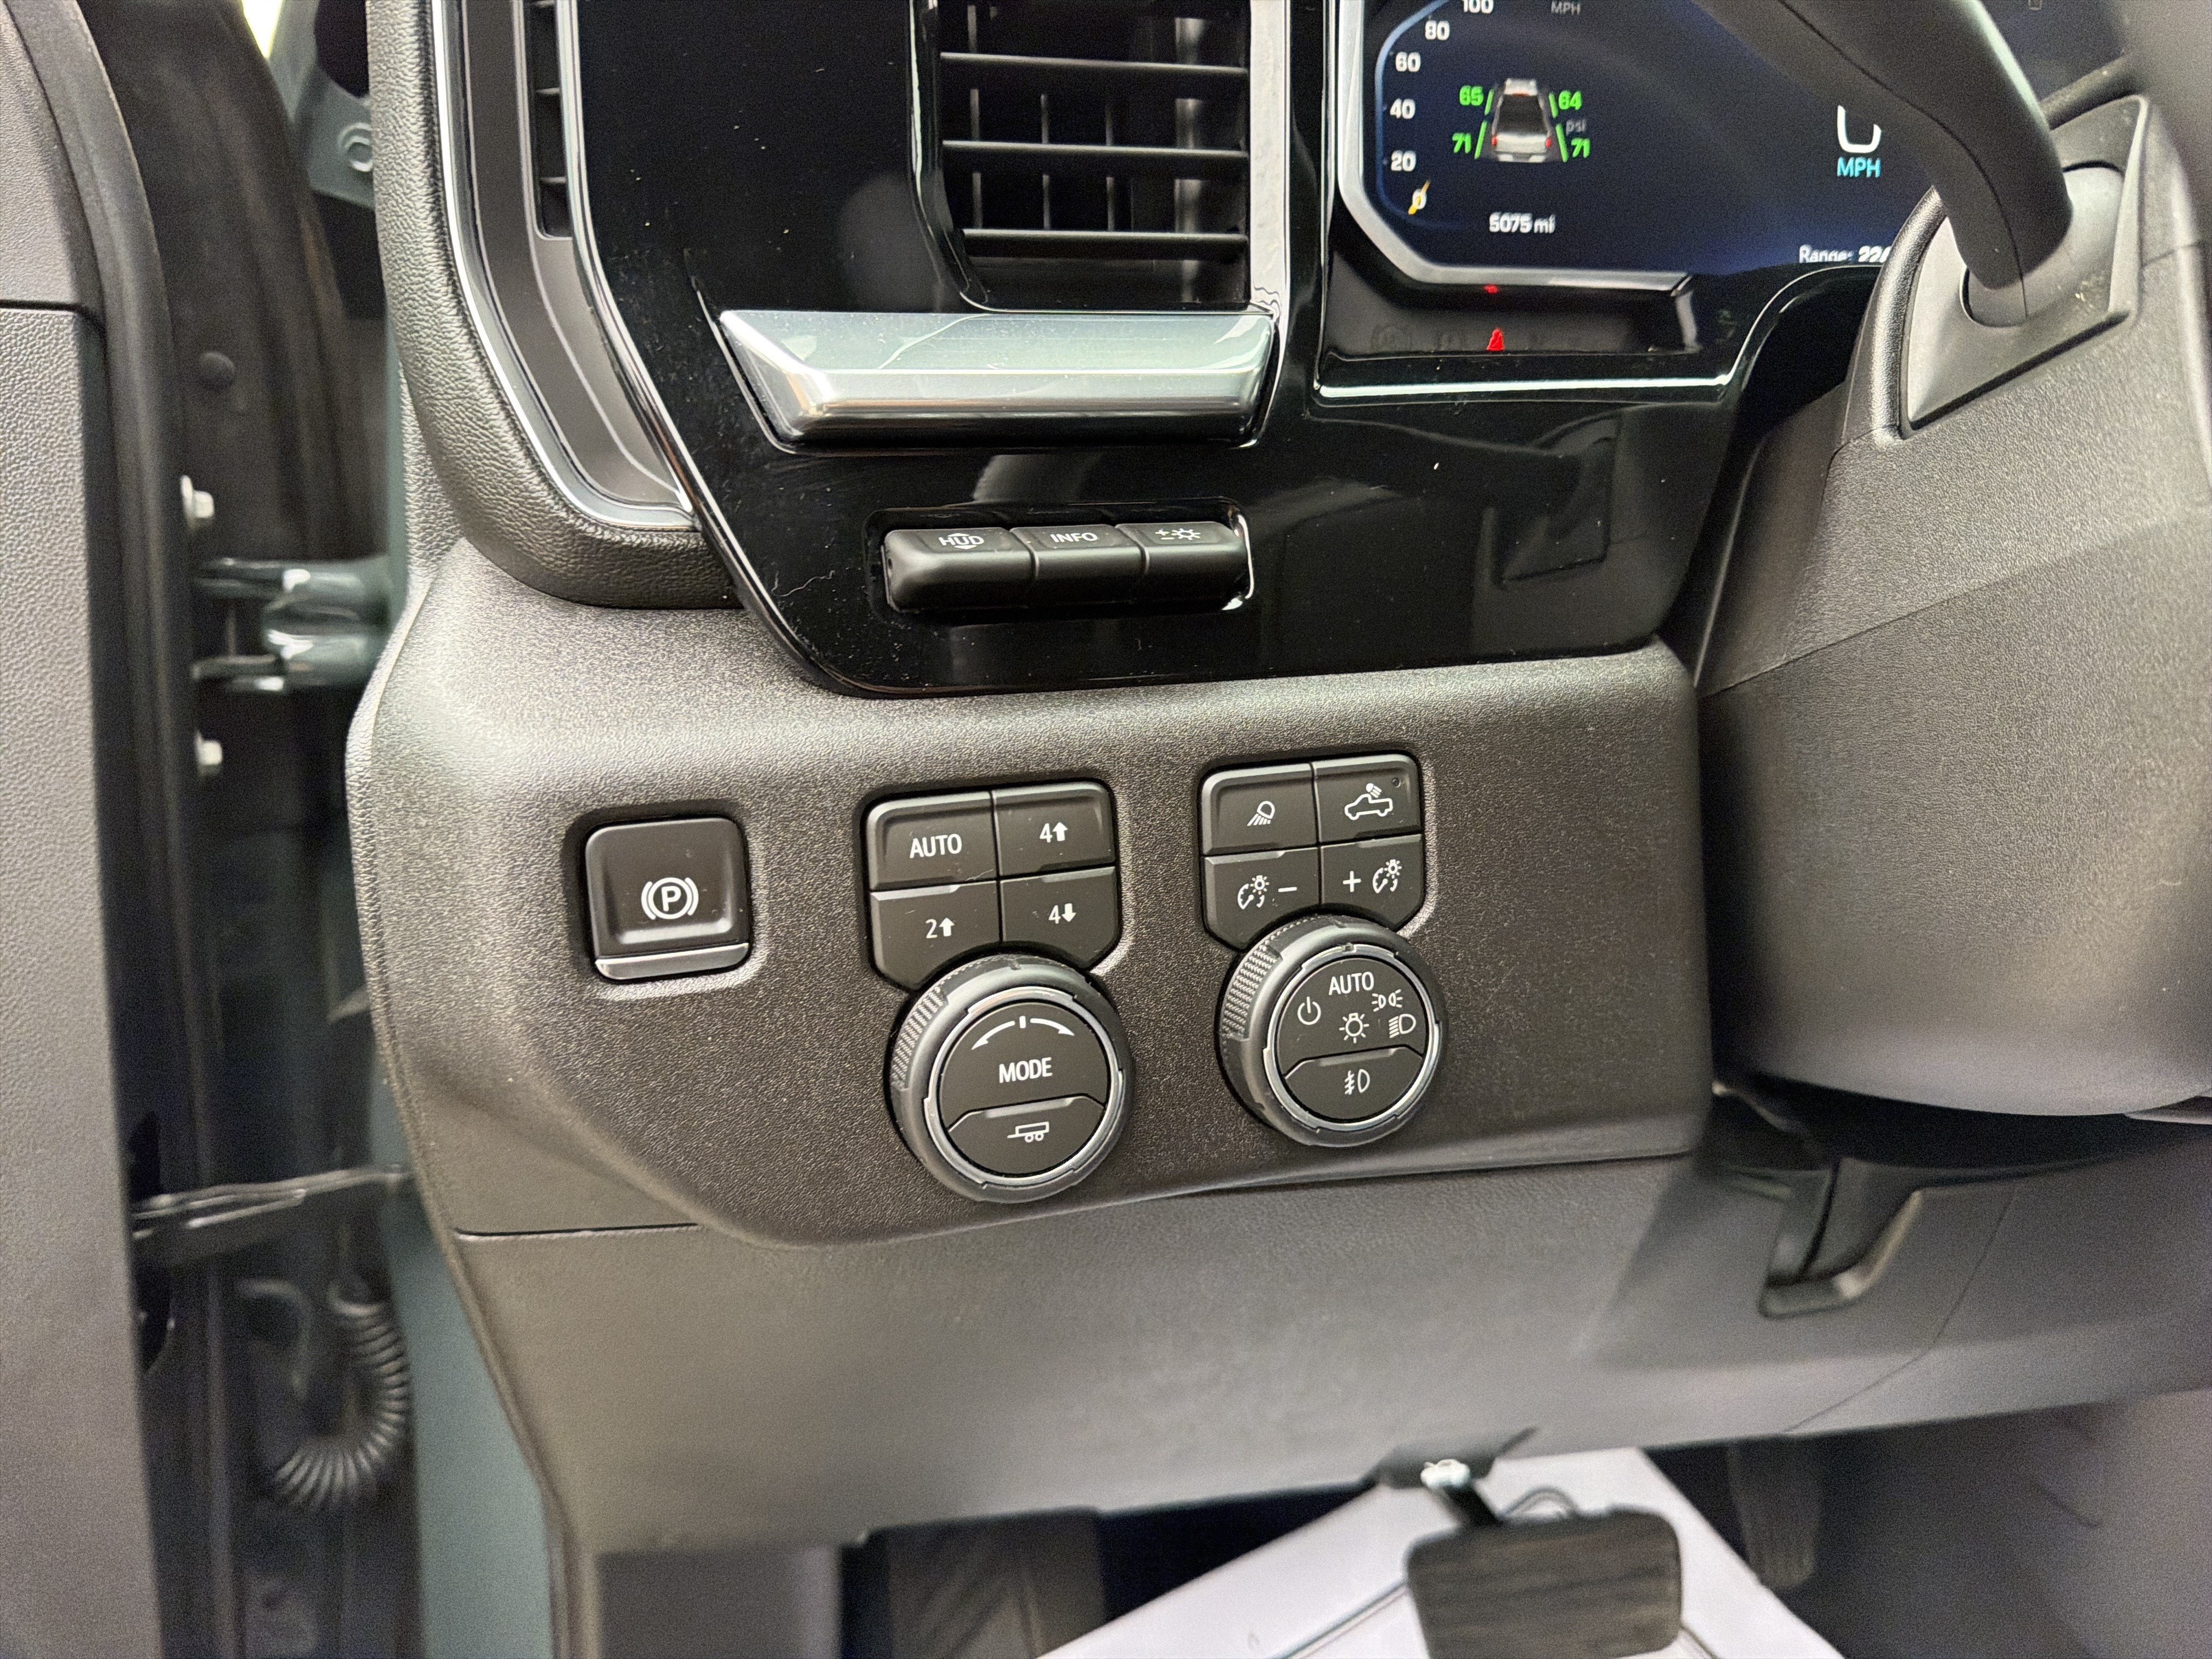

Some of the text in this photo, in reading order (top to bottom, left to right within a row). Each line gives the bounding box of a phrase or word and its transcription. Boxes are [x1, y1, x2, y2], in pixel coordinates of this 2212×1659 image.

[1463, 0, 1494, 14] 100
[1551, 1, 1582, 15] MPH
[1425, 20, 1450, 40] 80
[1395, 52, 1421, 72] 60
[1459, 86, 1483, 106] 65
[1559, 91, 1582, 110] 64
[1390, 99, 1415, 119] 40
[1566, 119, 1587, 134] psi
[1452, 133, 1472, 153] 71
[1571, 138, 1590, 157] 71
[1391, 151, 1416, 171] 20
[1837, 157, 1881, 178] MPH
[1489, 212, 1556, 234] 5075 mi
[939, 533, 984, 548] HUD
[1050, 532, 1098, 543] INFO
[909, 833, 963, 859] AUTO
[1328, 971, 1374, 996] AUTO
[998, 1057, 1053, 1084] MODE
